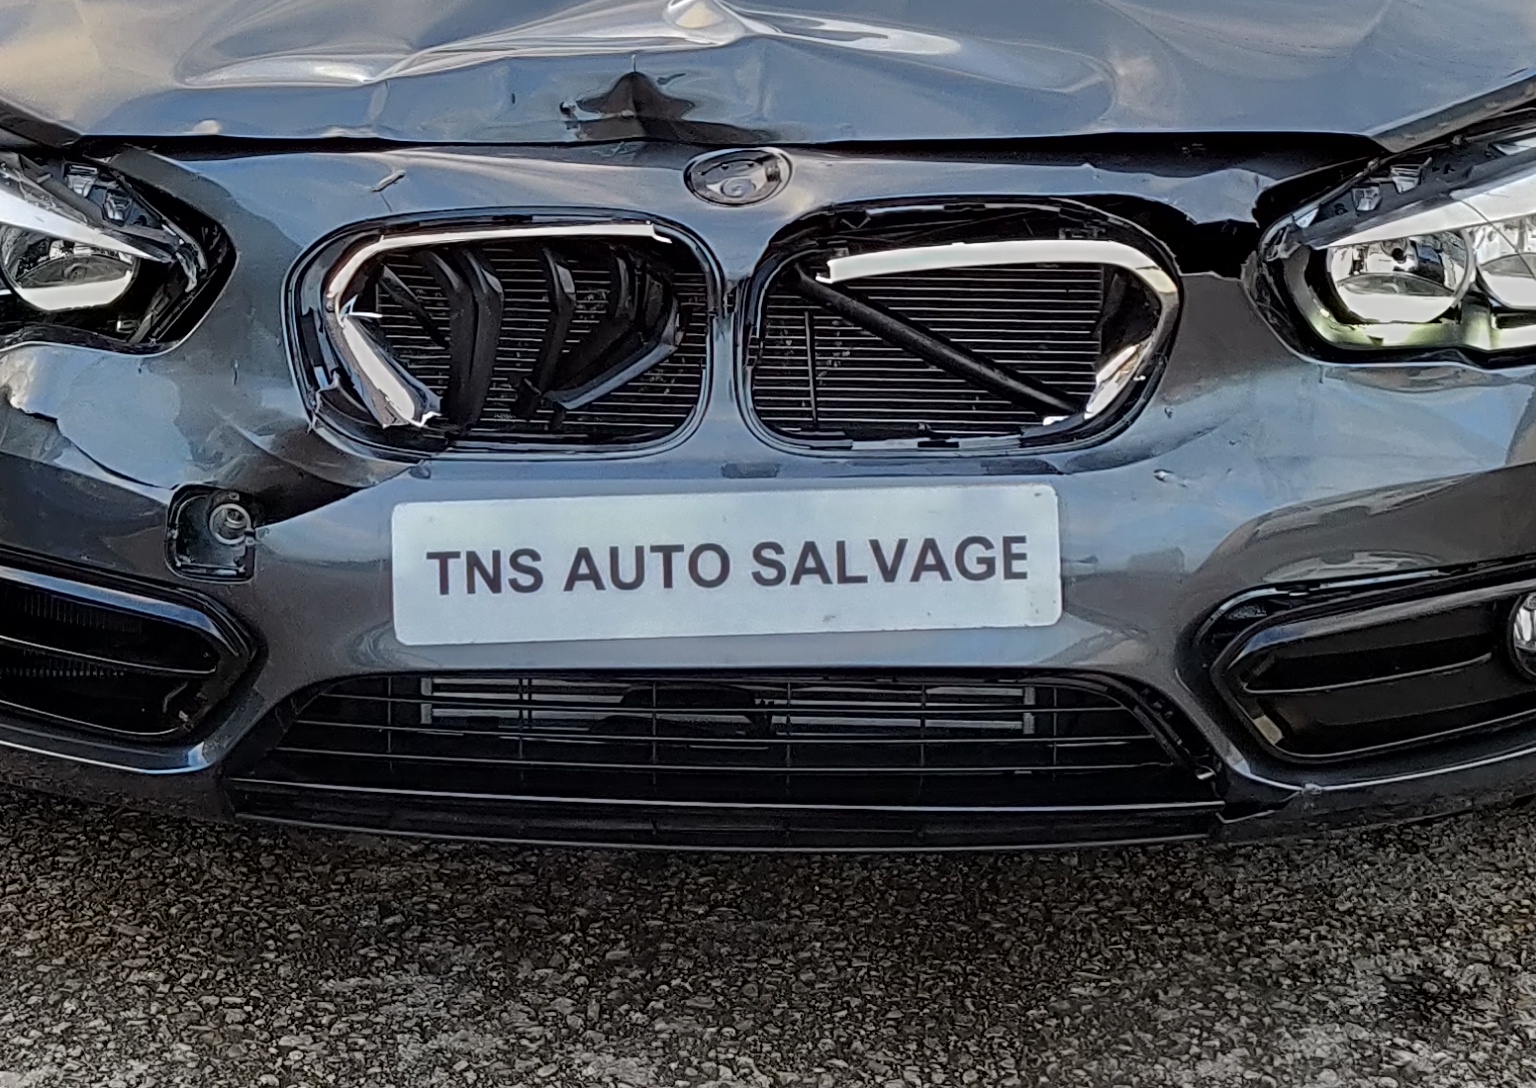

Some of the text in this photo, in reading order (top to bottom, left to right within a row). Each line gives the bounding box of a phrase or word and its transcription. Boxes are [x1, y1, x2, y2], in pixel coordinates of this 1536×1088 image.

[426, 534, 1029, 596] TNS AUTO SALVAGE
